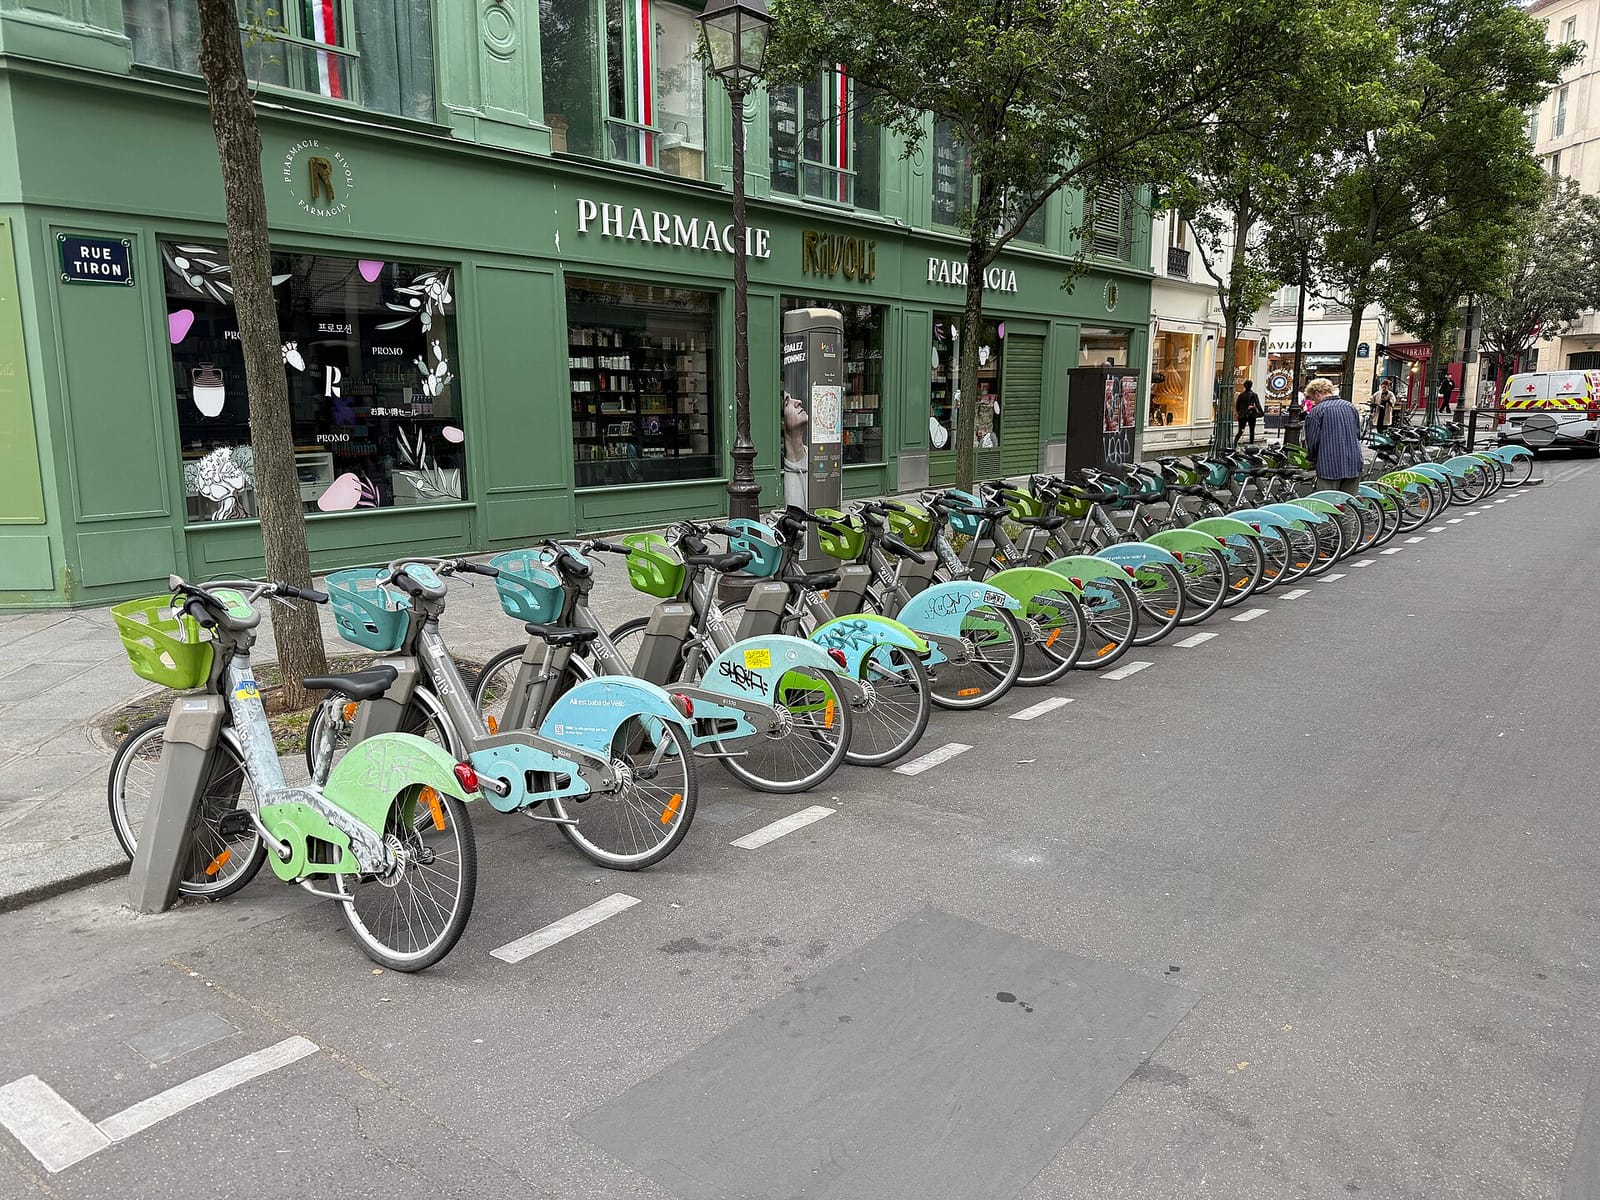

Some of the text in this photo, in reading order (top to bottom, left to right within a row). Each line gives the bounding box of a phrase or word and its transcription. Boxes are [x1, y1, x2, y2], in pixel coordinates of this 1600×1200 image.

[284, 140, 319, 183] PHARMACIE
[334, 151, 353, 188] RIVOLI
[309, 156, 335, 201] R
[298, 199, 347, 217] FARMACIA
[80, 246, 112, 260] RUE
[73, 261, 122, 276] TIRON
[372, 347, 403, 356] PROMO
[324, 365, 342, 398] R
[316, 433, 350, 442] PROMO
